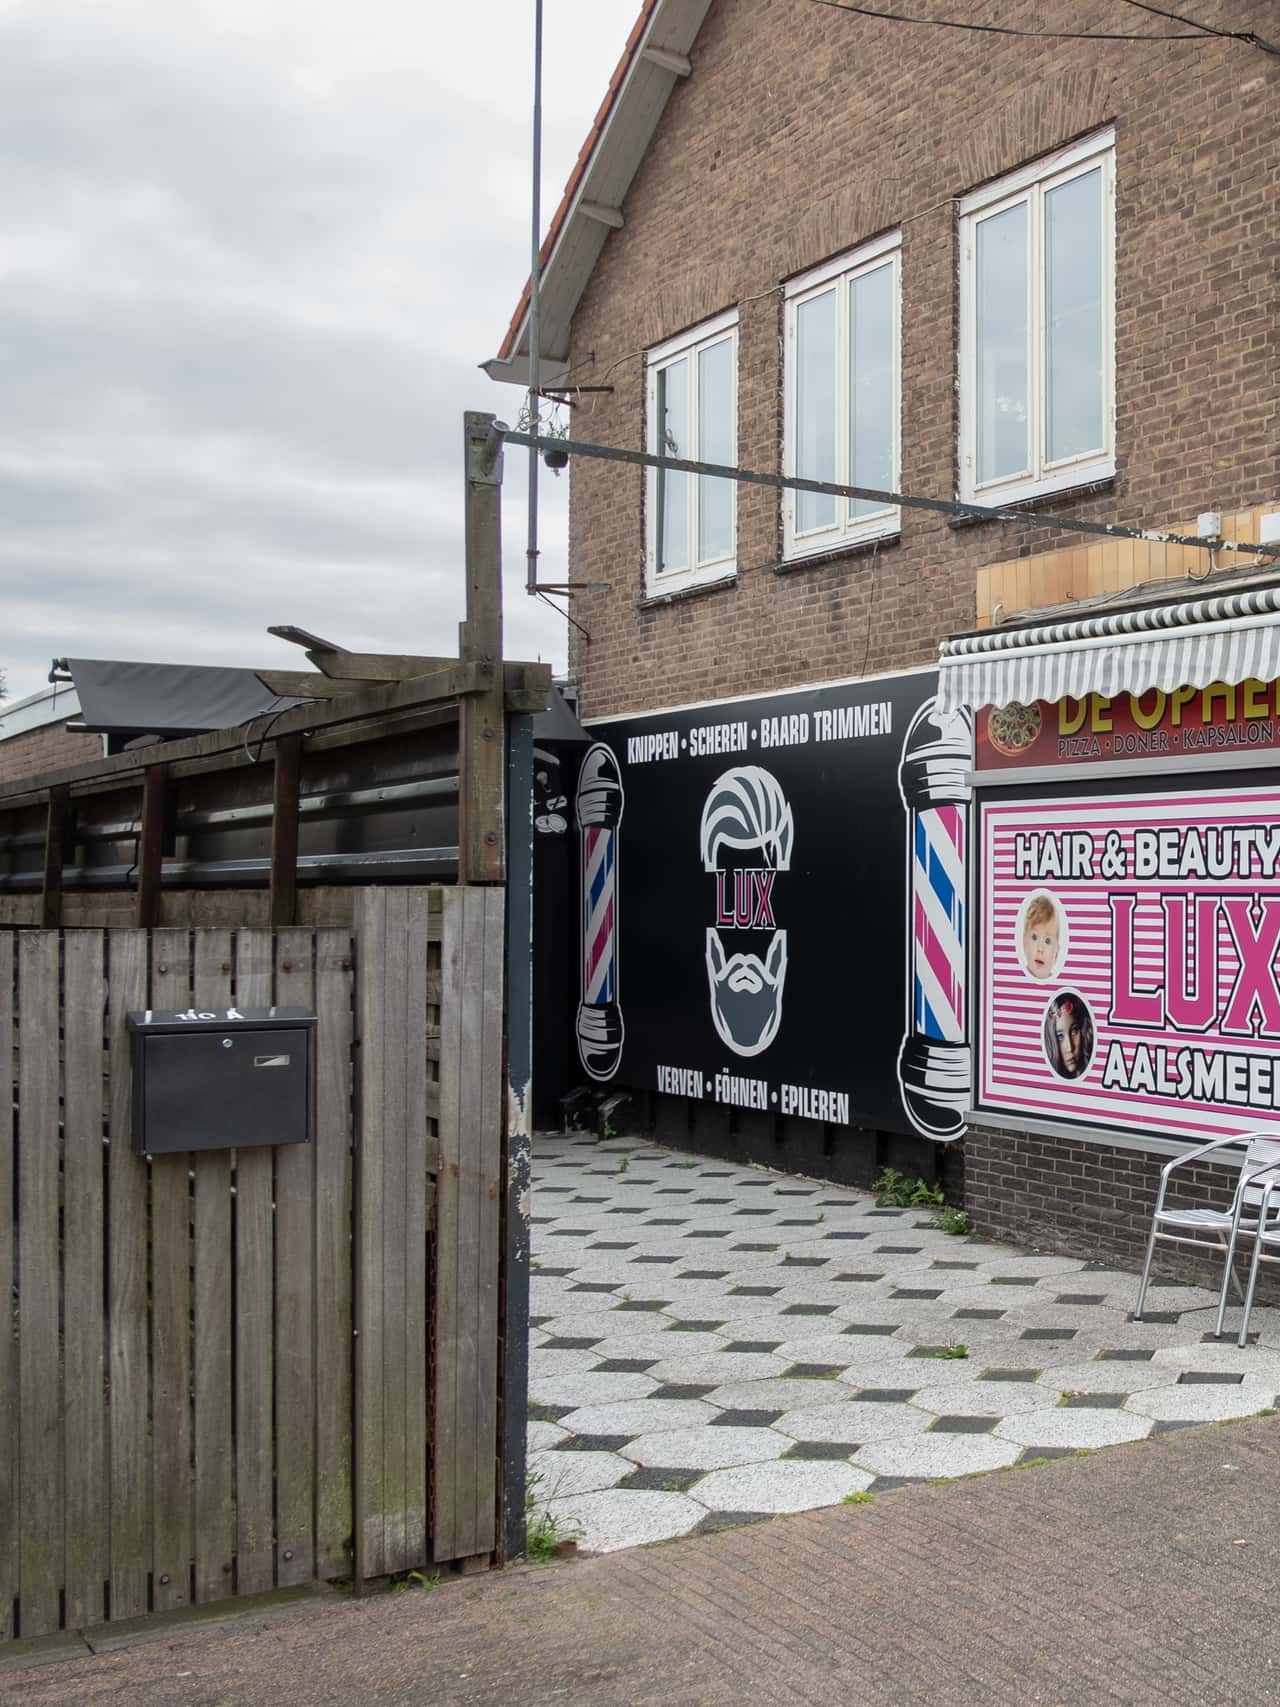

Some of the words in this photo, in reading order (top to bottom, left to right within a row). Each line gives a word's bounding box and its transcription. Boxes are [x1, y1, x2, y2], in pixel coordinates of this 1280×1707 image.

[627, 731, 679, 765] KNIPPEN
[689, 721, 748, 757] SCHEREN
[759, 711, 809, 748] BAARD
[814, 701, 893, 742] TRIMMEN
[1056, 691, 1115, 738] DE
[1057, 737, 1102, 759] PIZZA
[1113, 731, 1169, 754] DONER
[1182, 723, 1274, 751] KAPSALON
[1014, 829, 1094, 880] HAIR
[1100, 829, 1127, 880] &
[715, 868, 777, 930] LUX
[656, 1064, 704, 1100] VERVEN
[714, 1067, 768, 1111] FÖHNEN
[780, 1083, 850, 1125] EPILEREN
